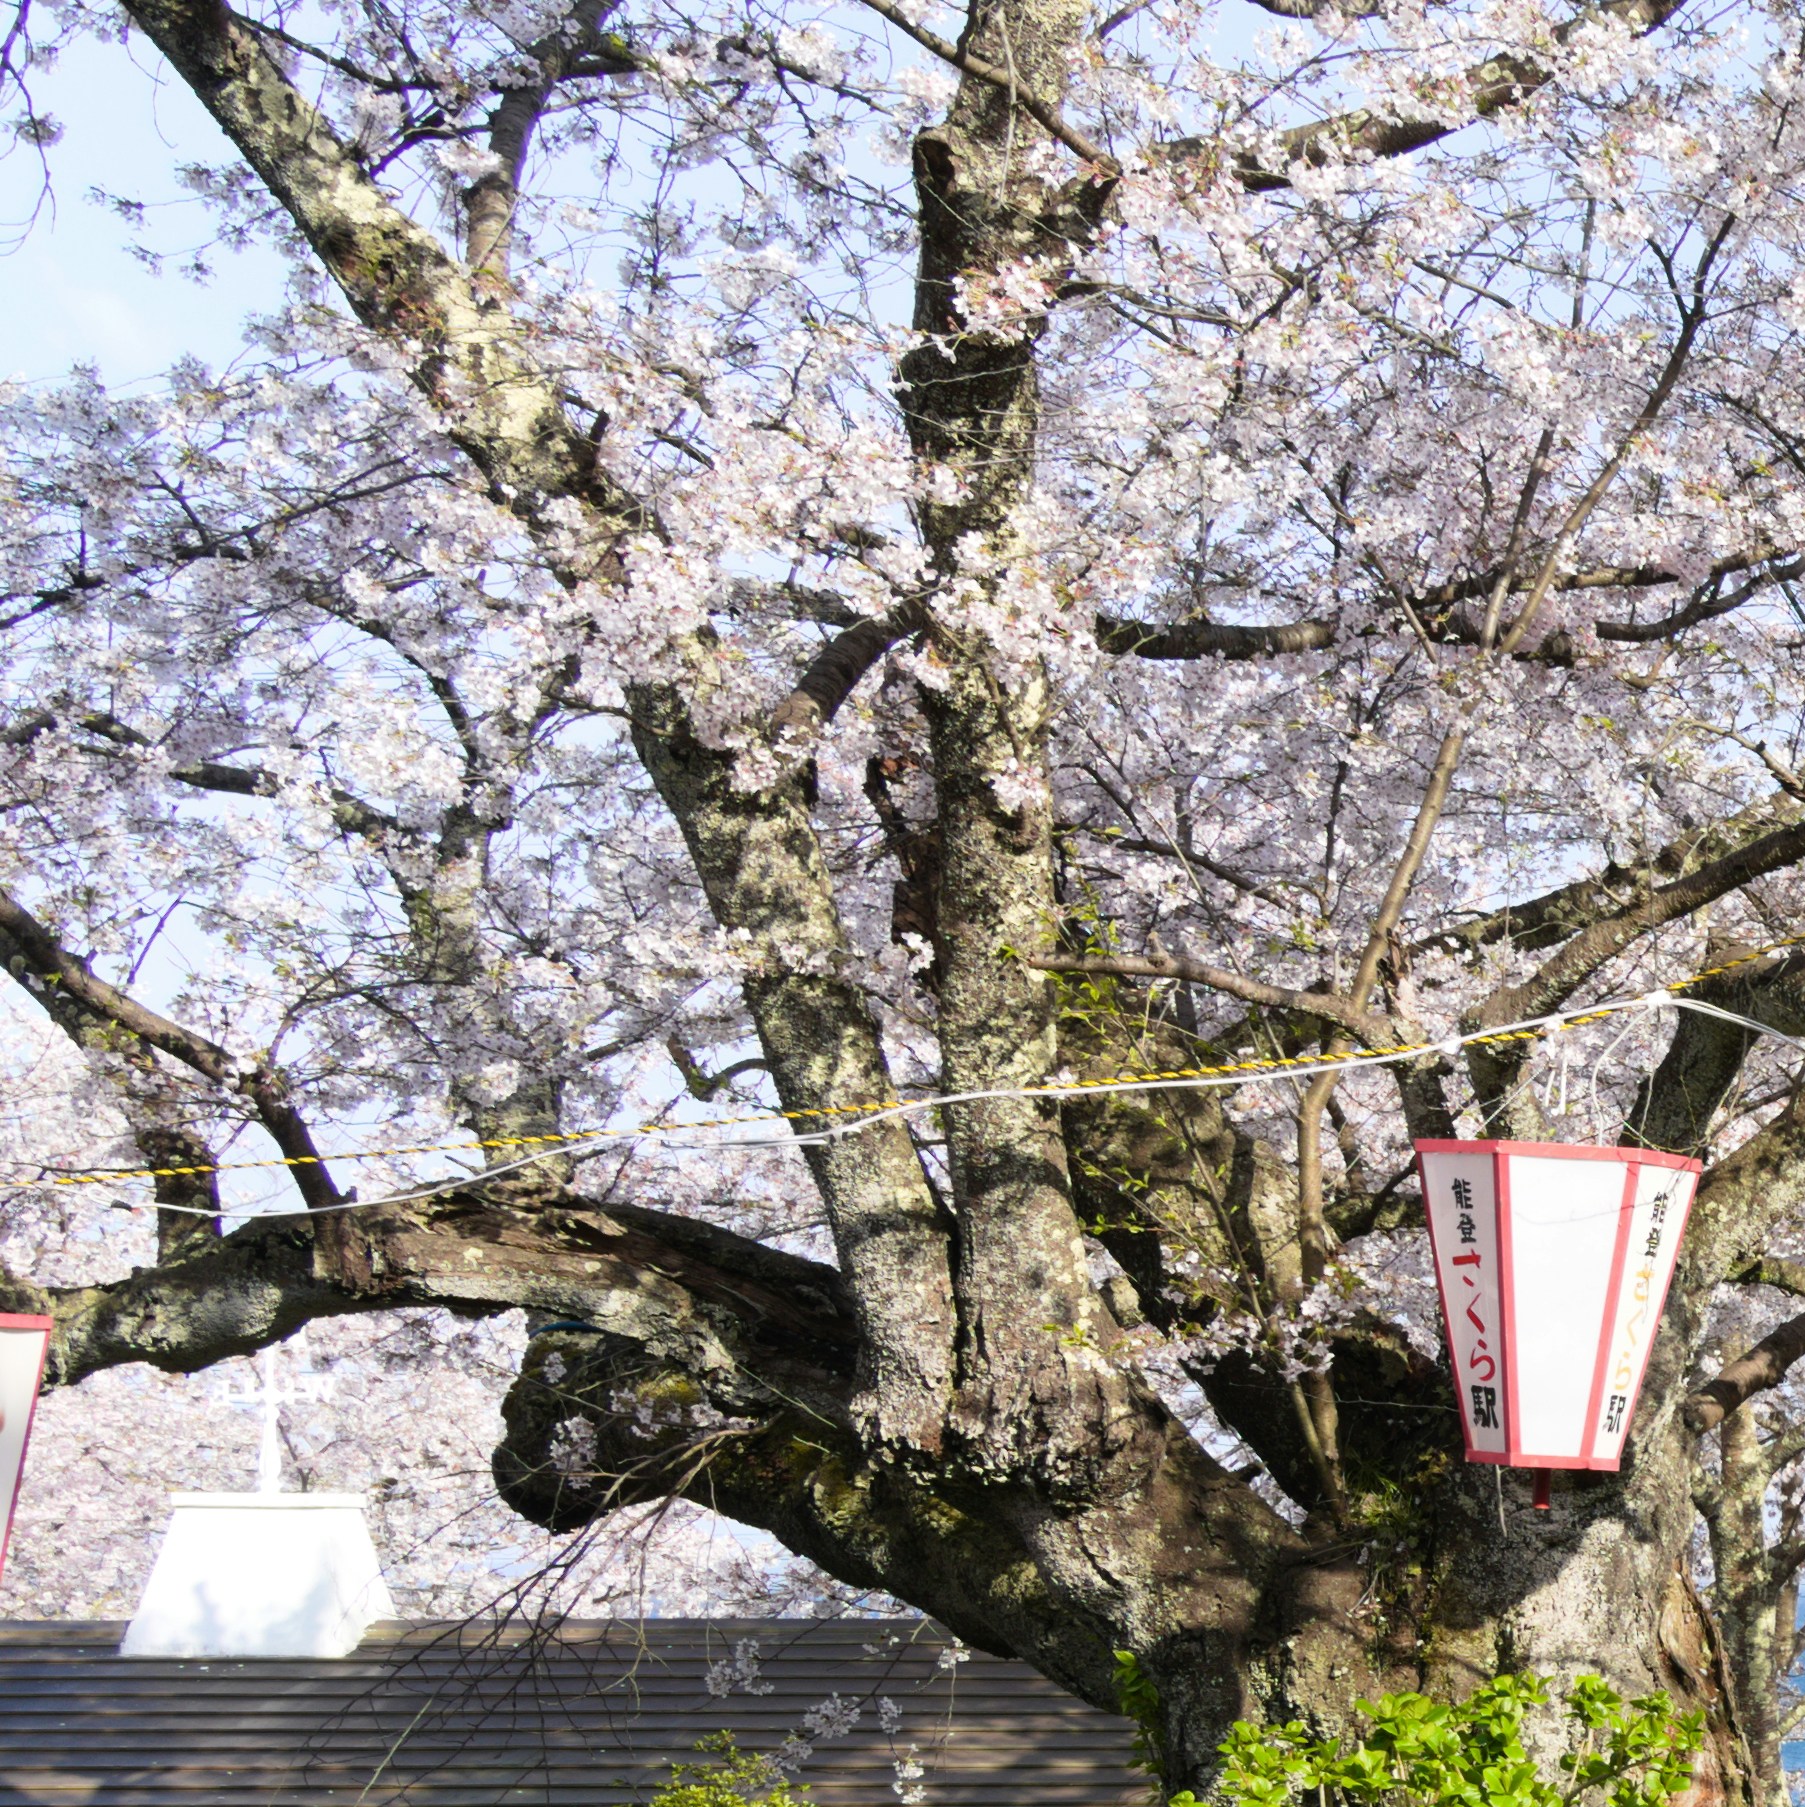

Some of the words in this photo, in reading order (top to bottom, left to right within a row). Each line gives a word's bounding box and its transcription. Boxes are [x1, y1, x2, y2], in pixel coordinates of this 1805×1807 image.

[1452, 1178, 1499, 1430] 能登さくら駅
[1603, 1191, 1669, 1435] 能登さくら駅
